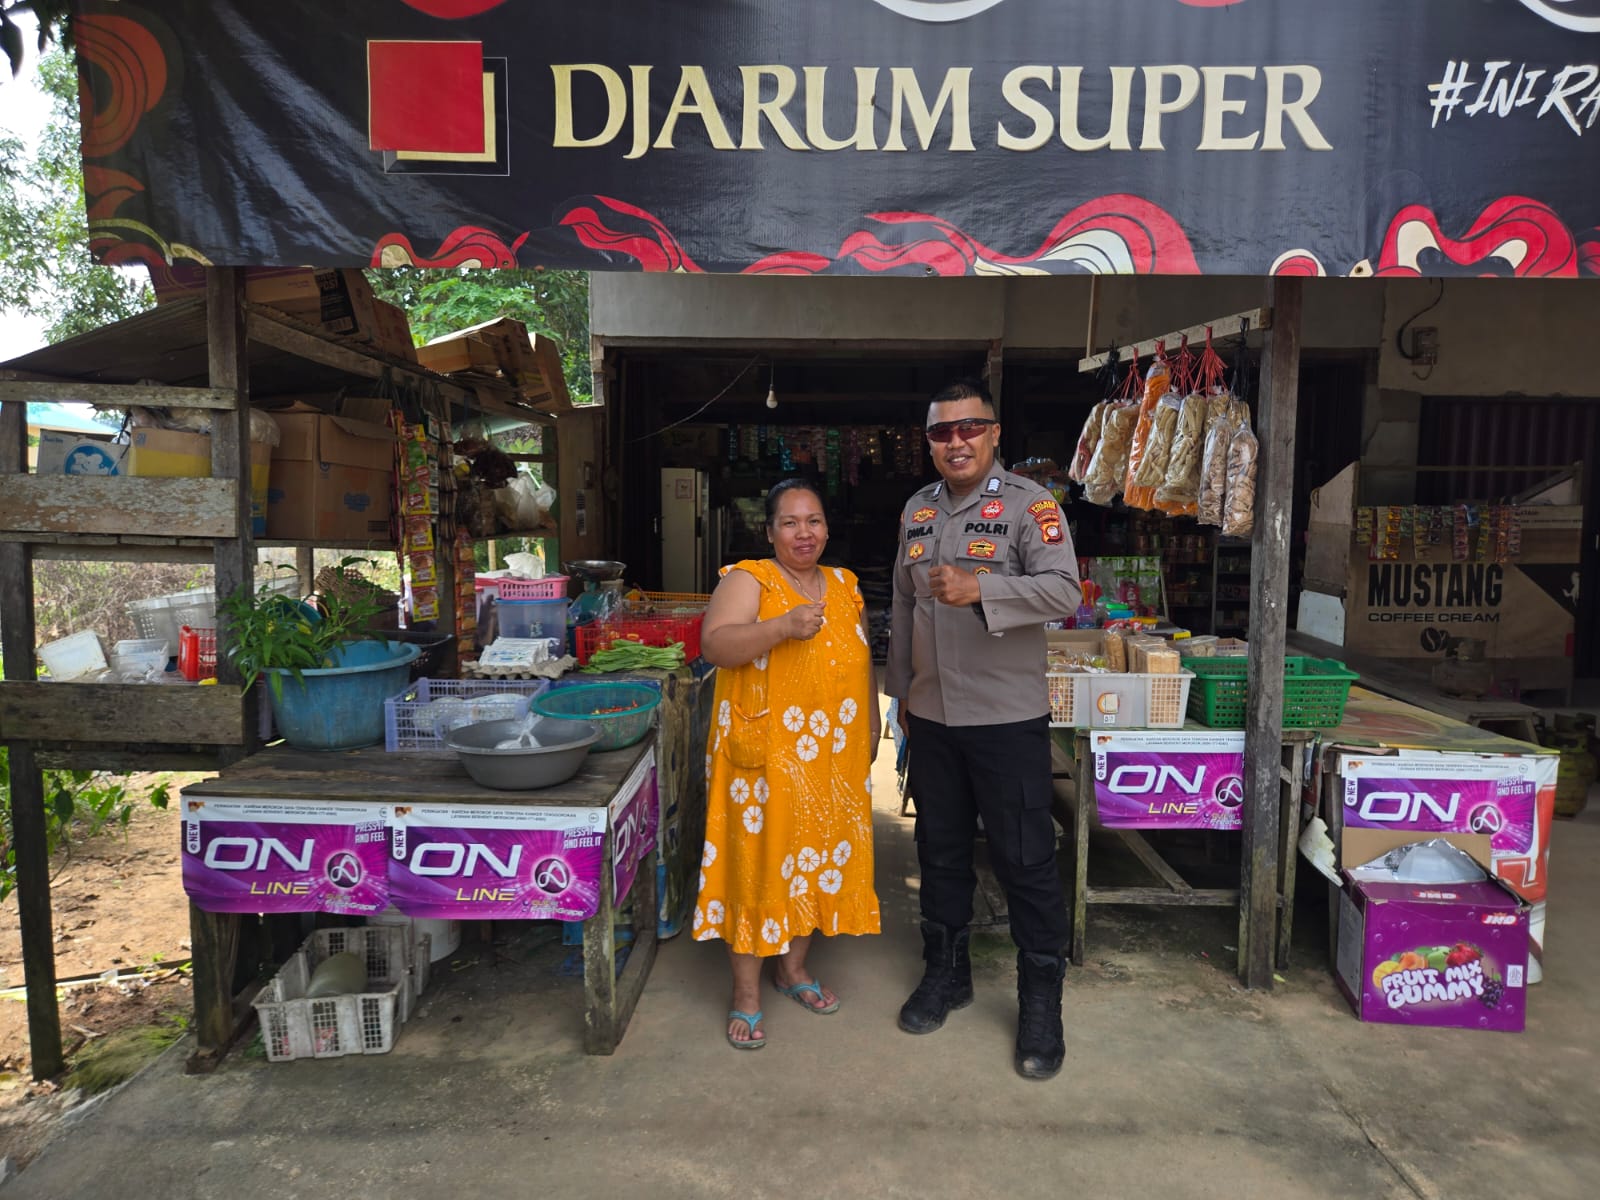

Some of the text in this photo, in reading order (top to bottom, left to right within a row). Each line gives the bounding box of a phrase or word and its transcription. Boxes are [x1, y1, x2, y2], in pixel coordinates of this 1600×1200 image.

[1427, 60, 1547, 129] #INI
[550, 64, 1333, 159] DJARUM SUPER
[964, 522, 1009, 535] POLRI
[1367, 563, 1503, 607] MUSTANG
[1368, 612, 1500, 622] COFFEE CREAM
[1097, 754, 1106, 771] NEW
[1107, 765, 1206, 794] ON
[1347, 780, 1356, 797] NEW
[1510, 785, 1524, 795] FEEL
[1525, 784, 1532, 794] IT
[1148, 802, 1198, 814] LINE
[1359, 792, 1461, 822] ON
[189, 823, 199, 842] NEW
[370, 831, 386, 843] FEEL
[395, 829, 404, 848] NEW
[579, 837, 594, 848] FEEL
[594, 836, 602, 847] IT
[204, 837, 315, 871] ON
[409, 843, 523, 878] ON
[251, 882, 310, 895] LINE
[456, 888, 516, 901] LINE
[1382, 968, 1439, 994] FRUIT
[1445, 959, 1482, 983] MIX
[1387, 974, 1485, 1009] GUMMY
